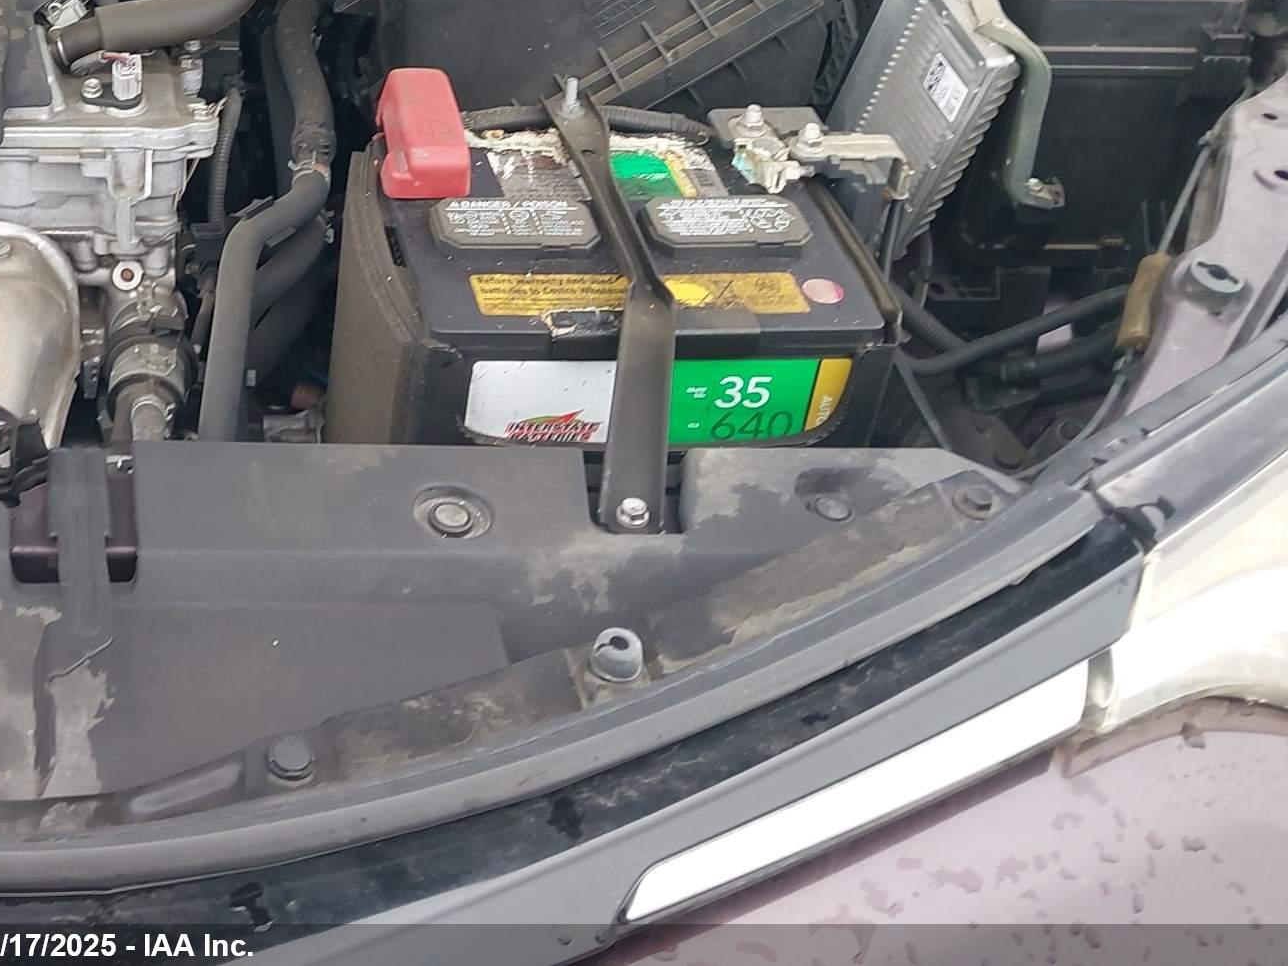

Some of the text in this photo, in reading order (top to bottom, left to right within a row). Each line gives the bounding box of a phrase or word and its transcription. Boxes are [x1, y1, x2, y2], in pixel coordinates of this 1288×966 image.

[714, 376, 773, 409] 35
[505, 422, 601, 433] INTERSTATE
[710, 410, 793, 440] 640
